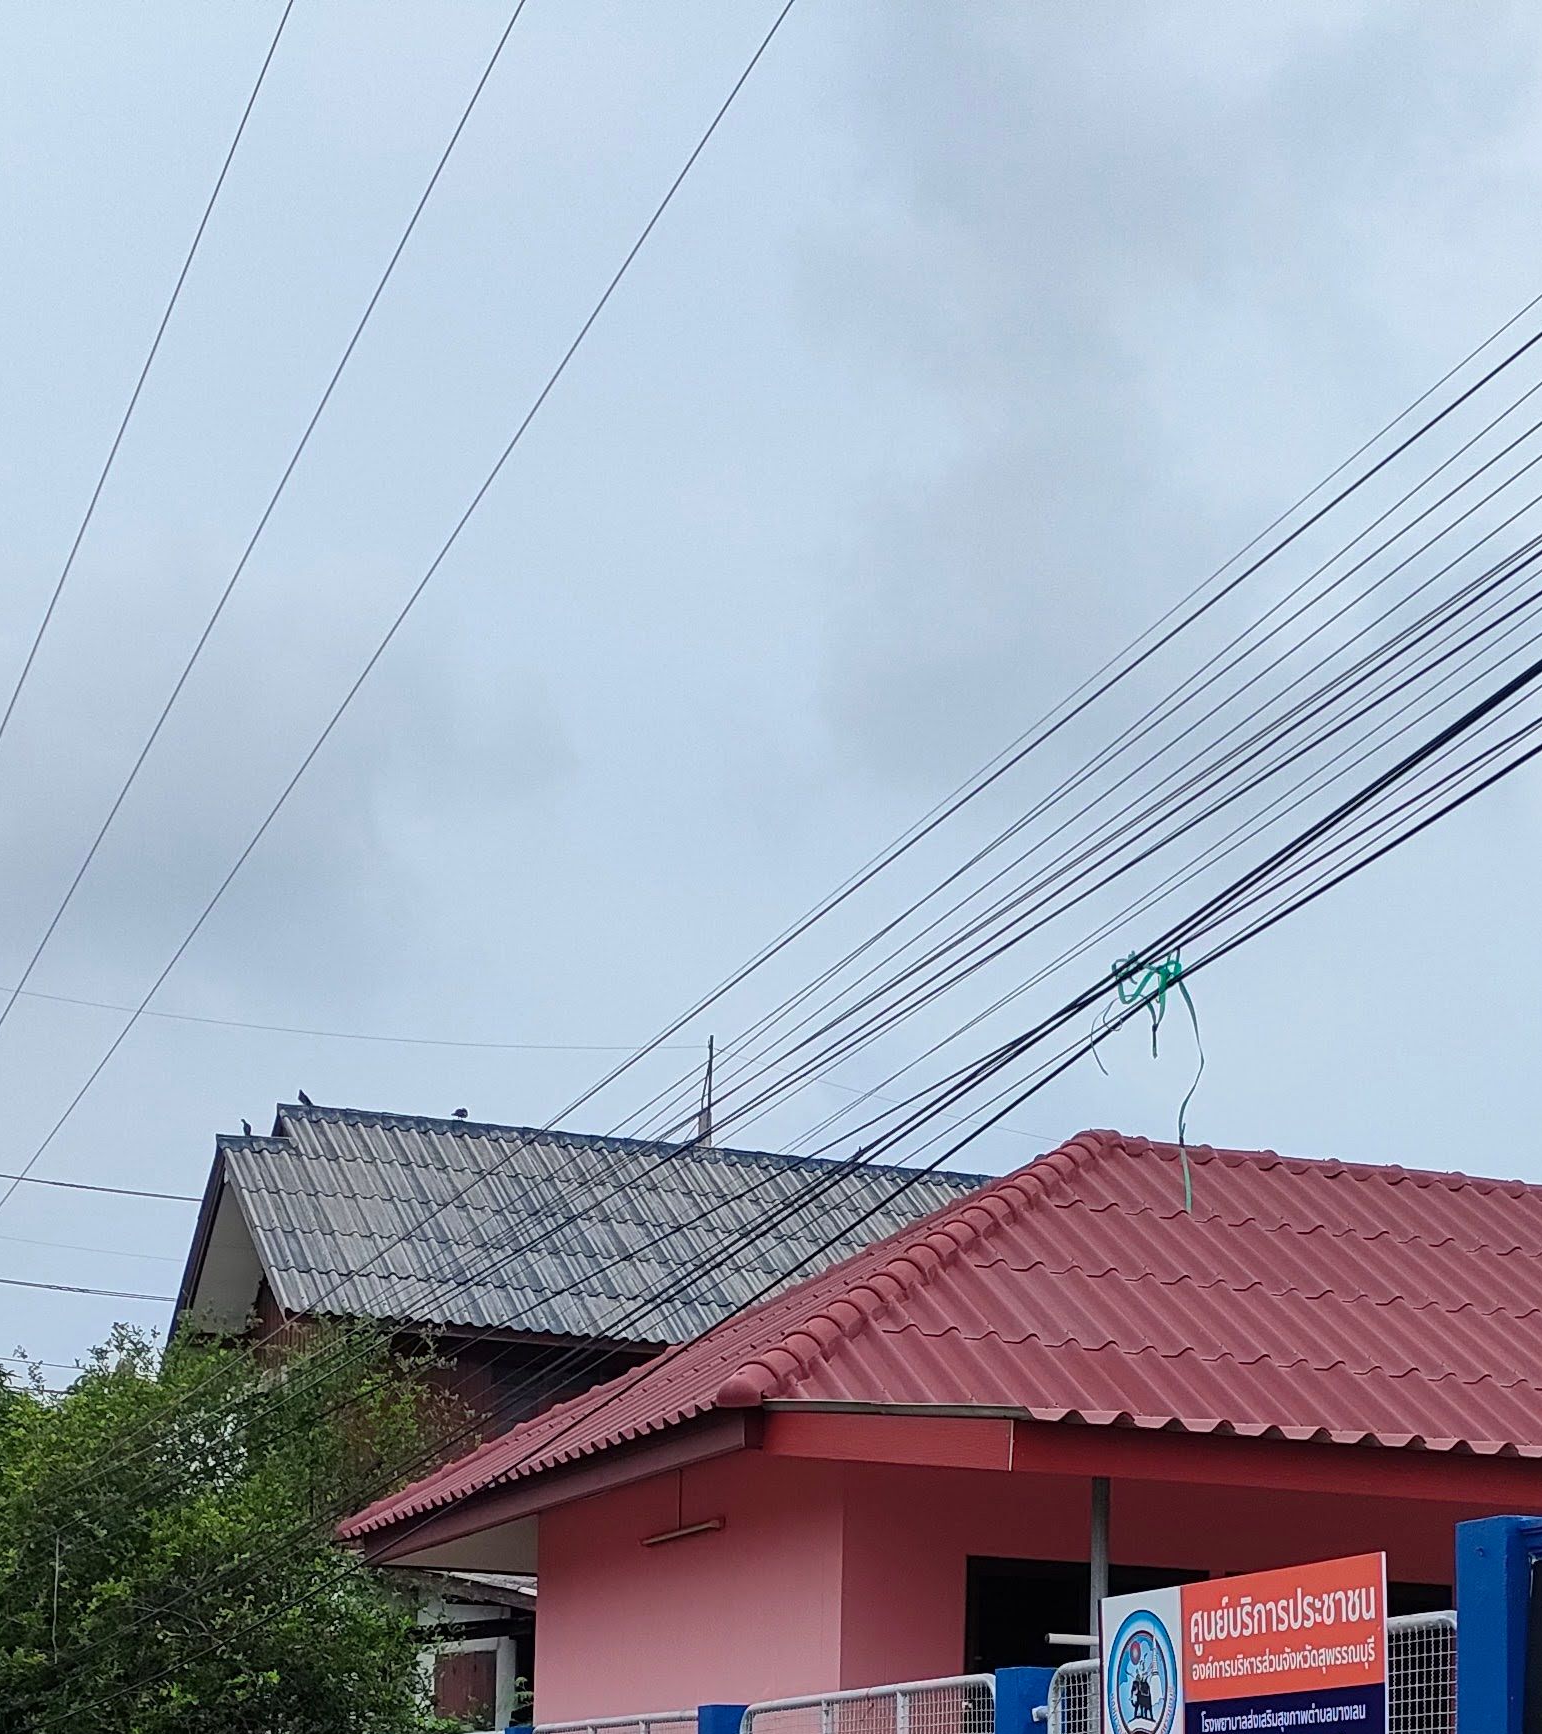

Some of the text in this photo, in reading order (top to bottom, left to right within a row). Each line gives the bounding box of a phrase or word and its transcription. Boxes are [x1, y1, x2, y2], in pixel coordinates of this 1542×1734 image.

[1190, 1586, 1376, 1656] ศูนย์บริการประชาชน
[1192, 1635, 1375, 1681] องค์การบริหารส่วนจังหวัดสุพรรณบุรี
[1201, 1703, 1366, 1733] โรงพยาบาลส่งเสริมสุขภาพตำบลบางเลน
